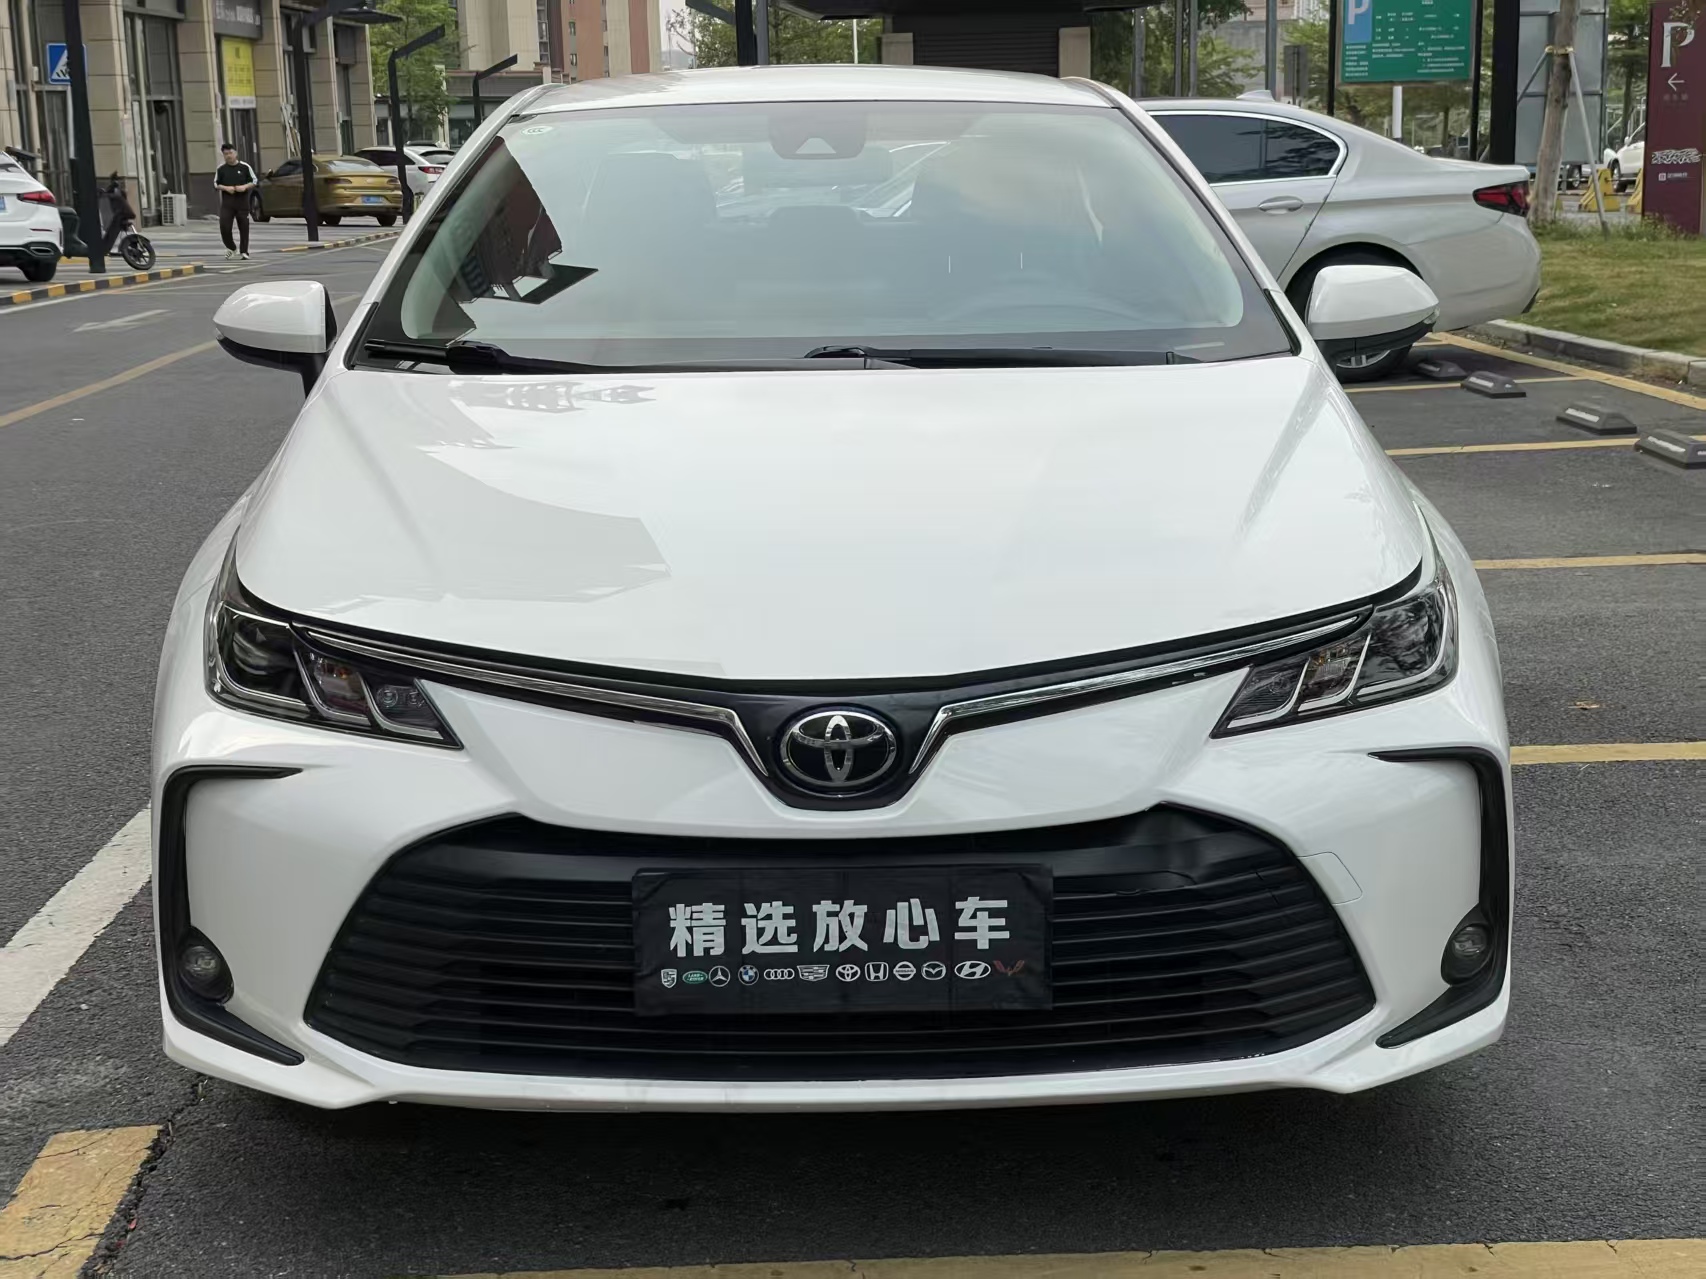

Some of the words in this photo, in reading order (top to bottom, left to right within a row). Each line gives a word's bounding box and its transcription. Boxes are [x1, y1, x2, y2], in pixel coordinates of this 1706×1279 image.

[1661, 22, 1695, 67] P
[668, 896, 1011, 958] 精选放心车
